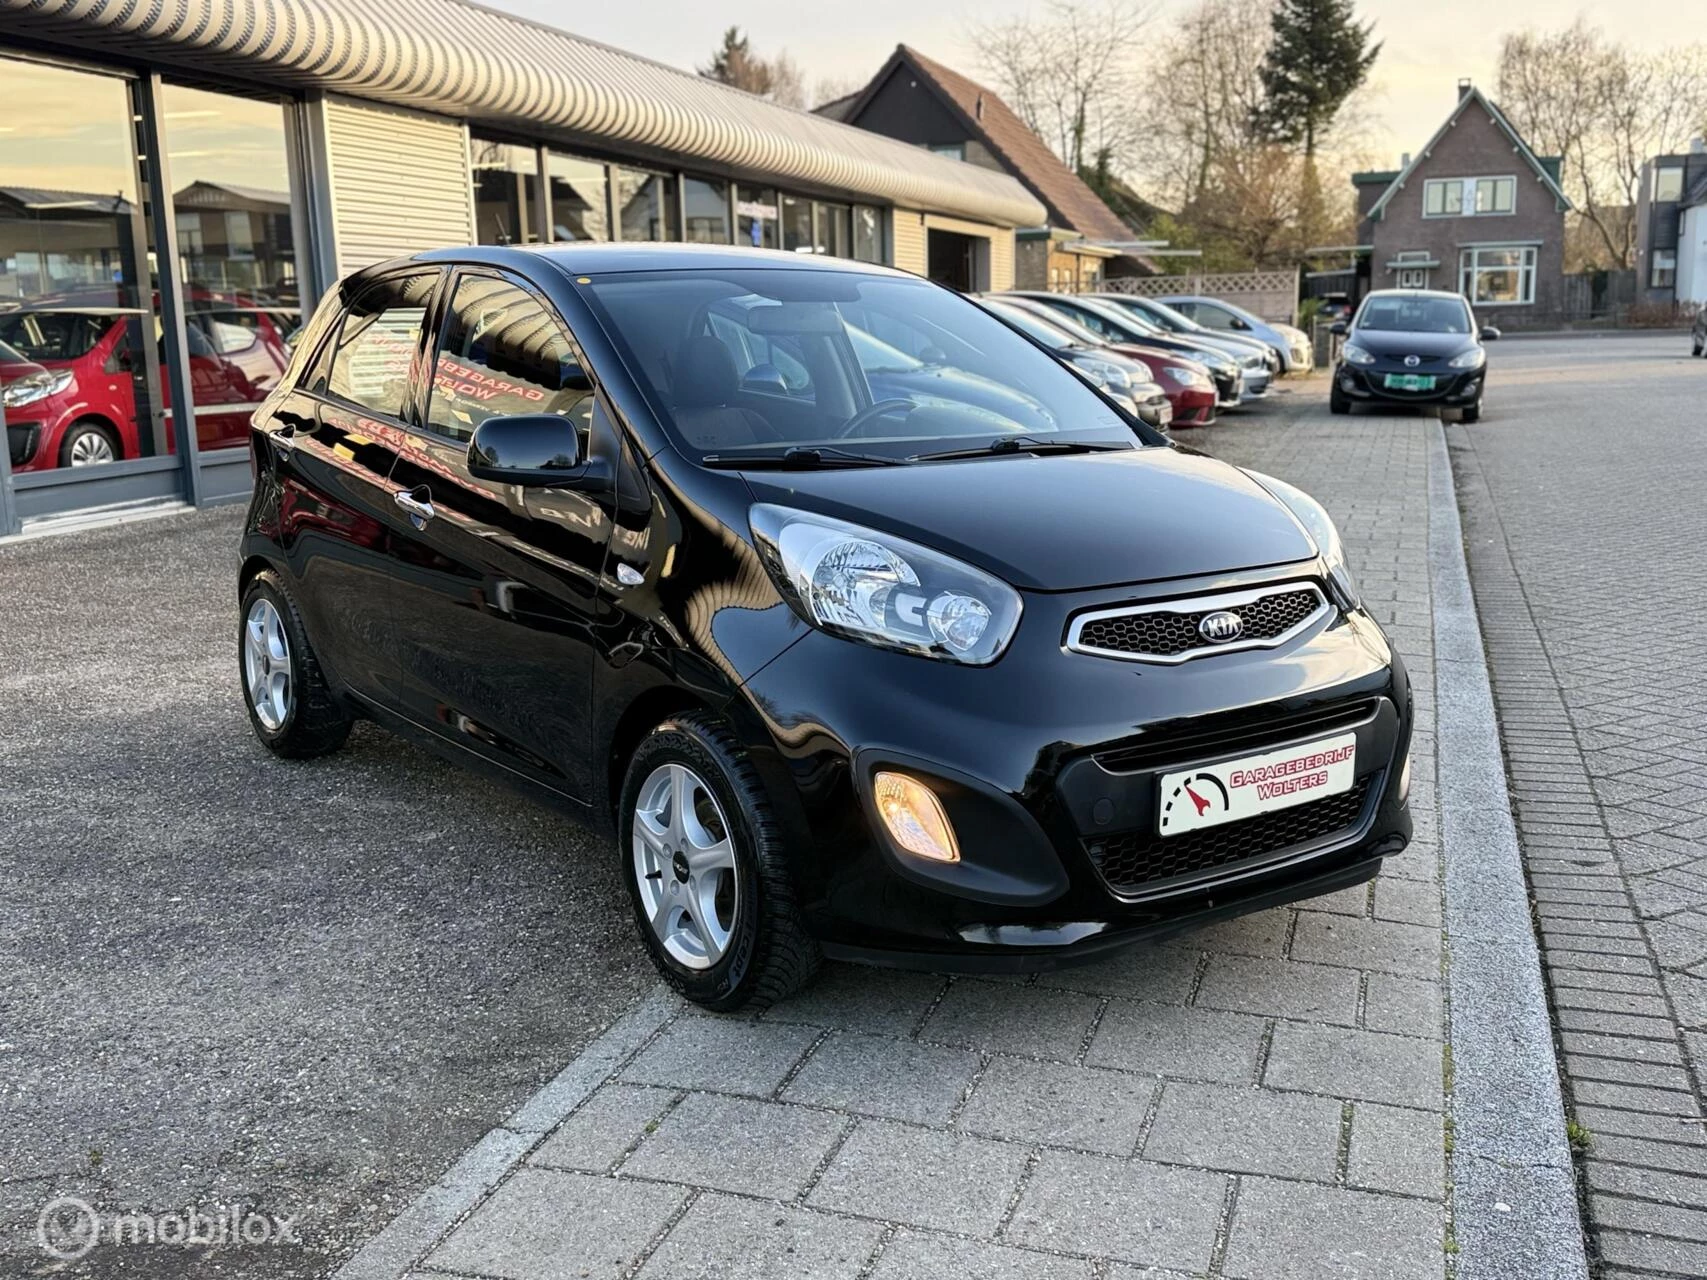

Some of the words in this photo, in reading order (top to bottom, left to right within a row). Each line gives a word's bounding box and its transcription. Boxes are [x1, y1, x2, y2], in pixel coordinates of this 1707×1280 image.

[1206, 616, 1240, 637] KIA
[1230, 745, 1354, 788] GARAGEBEDRIJF
[1257, 771, 1328, 800] WOLTERS
